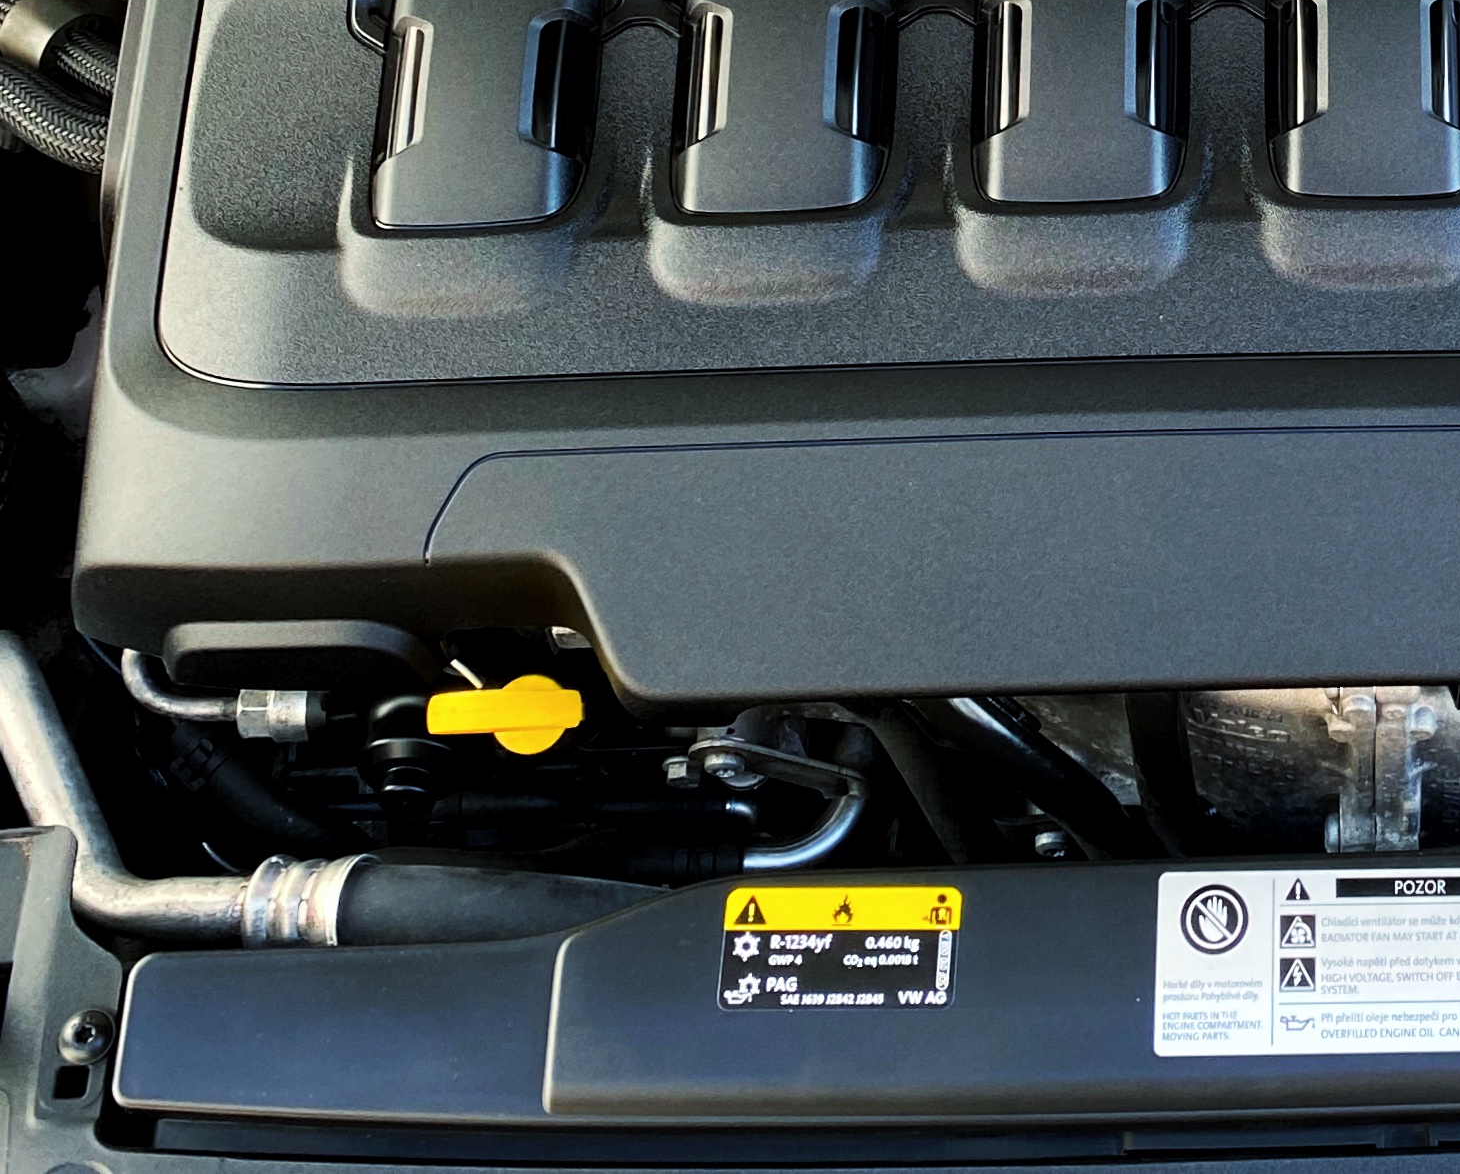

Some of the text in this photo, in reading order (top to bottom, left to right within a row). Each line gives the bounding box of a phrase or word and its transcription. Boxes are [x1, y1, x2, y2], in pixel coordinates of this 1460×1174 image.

[1394, 879, 1446, 895] POZOR
[1360, 916, 1405, 926] ventilátor
[1321, 933, 1369, 942] RADIATOR
[1371, 932, 1390, 942] FAN
[1392, 932, 1414, 941] MAY
[1415, 931, 1444, 941] START
[1446, 931, 1458, 940] AT
[770, 934, 920, 953] R-1234yf 0.460 kg
[768, 955, 794, 966] GWP
[794, 955, 803, 966] 4
[1321, 958, 1353, 969] Vysoké
[1390, 957, 1411, 968] před
[1413, 957, 1454, 968] dotykem
[1321, 973, 1347, 983] HIGH
[1396, 972, 1434, 981] SWITCH
[1435, 972, 1454, 981] OFF
[766, 977, 798, 993] PAG
[780, 994, 799, 1005] SAE
[897, 991, 921, 1004] VW
[925, 991, 948, 1005] AG
[1162, 1010, 1238, 1020] HOT PARTS IN THE
[1366, 1011, 1389, 1024] oleje
[1442, 1013, 1457, 1023] pro
[1162, 1022, 1195, 1030] ENGINE
[1162, 1032, 1199, 1041] MOVING
[1321, 1028, 1377, 1039] OVERFILLED
[1380, 1028, 1416, 1038] ENGINE
[1419, 1028, 1435, 1038] OIL
[1439, 1027, 1460, 1037] CAN
